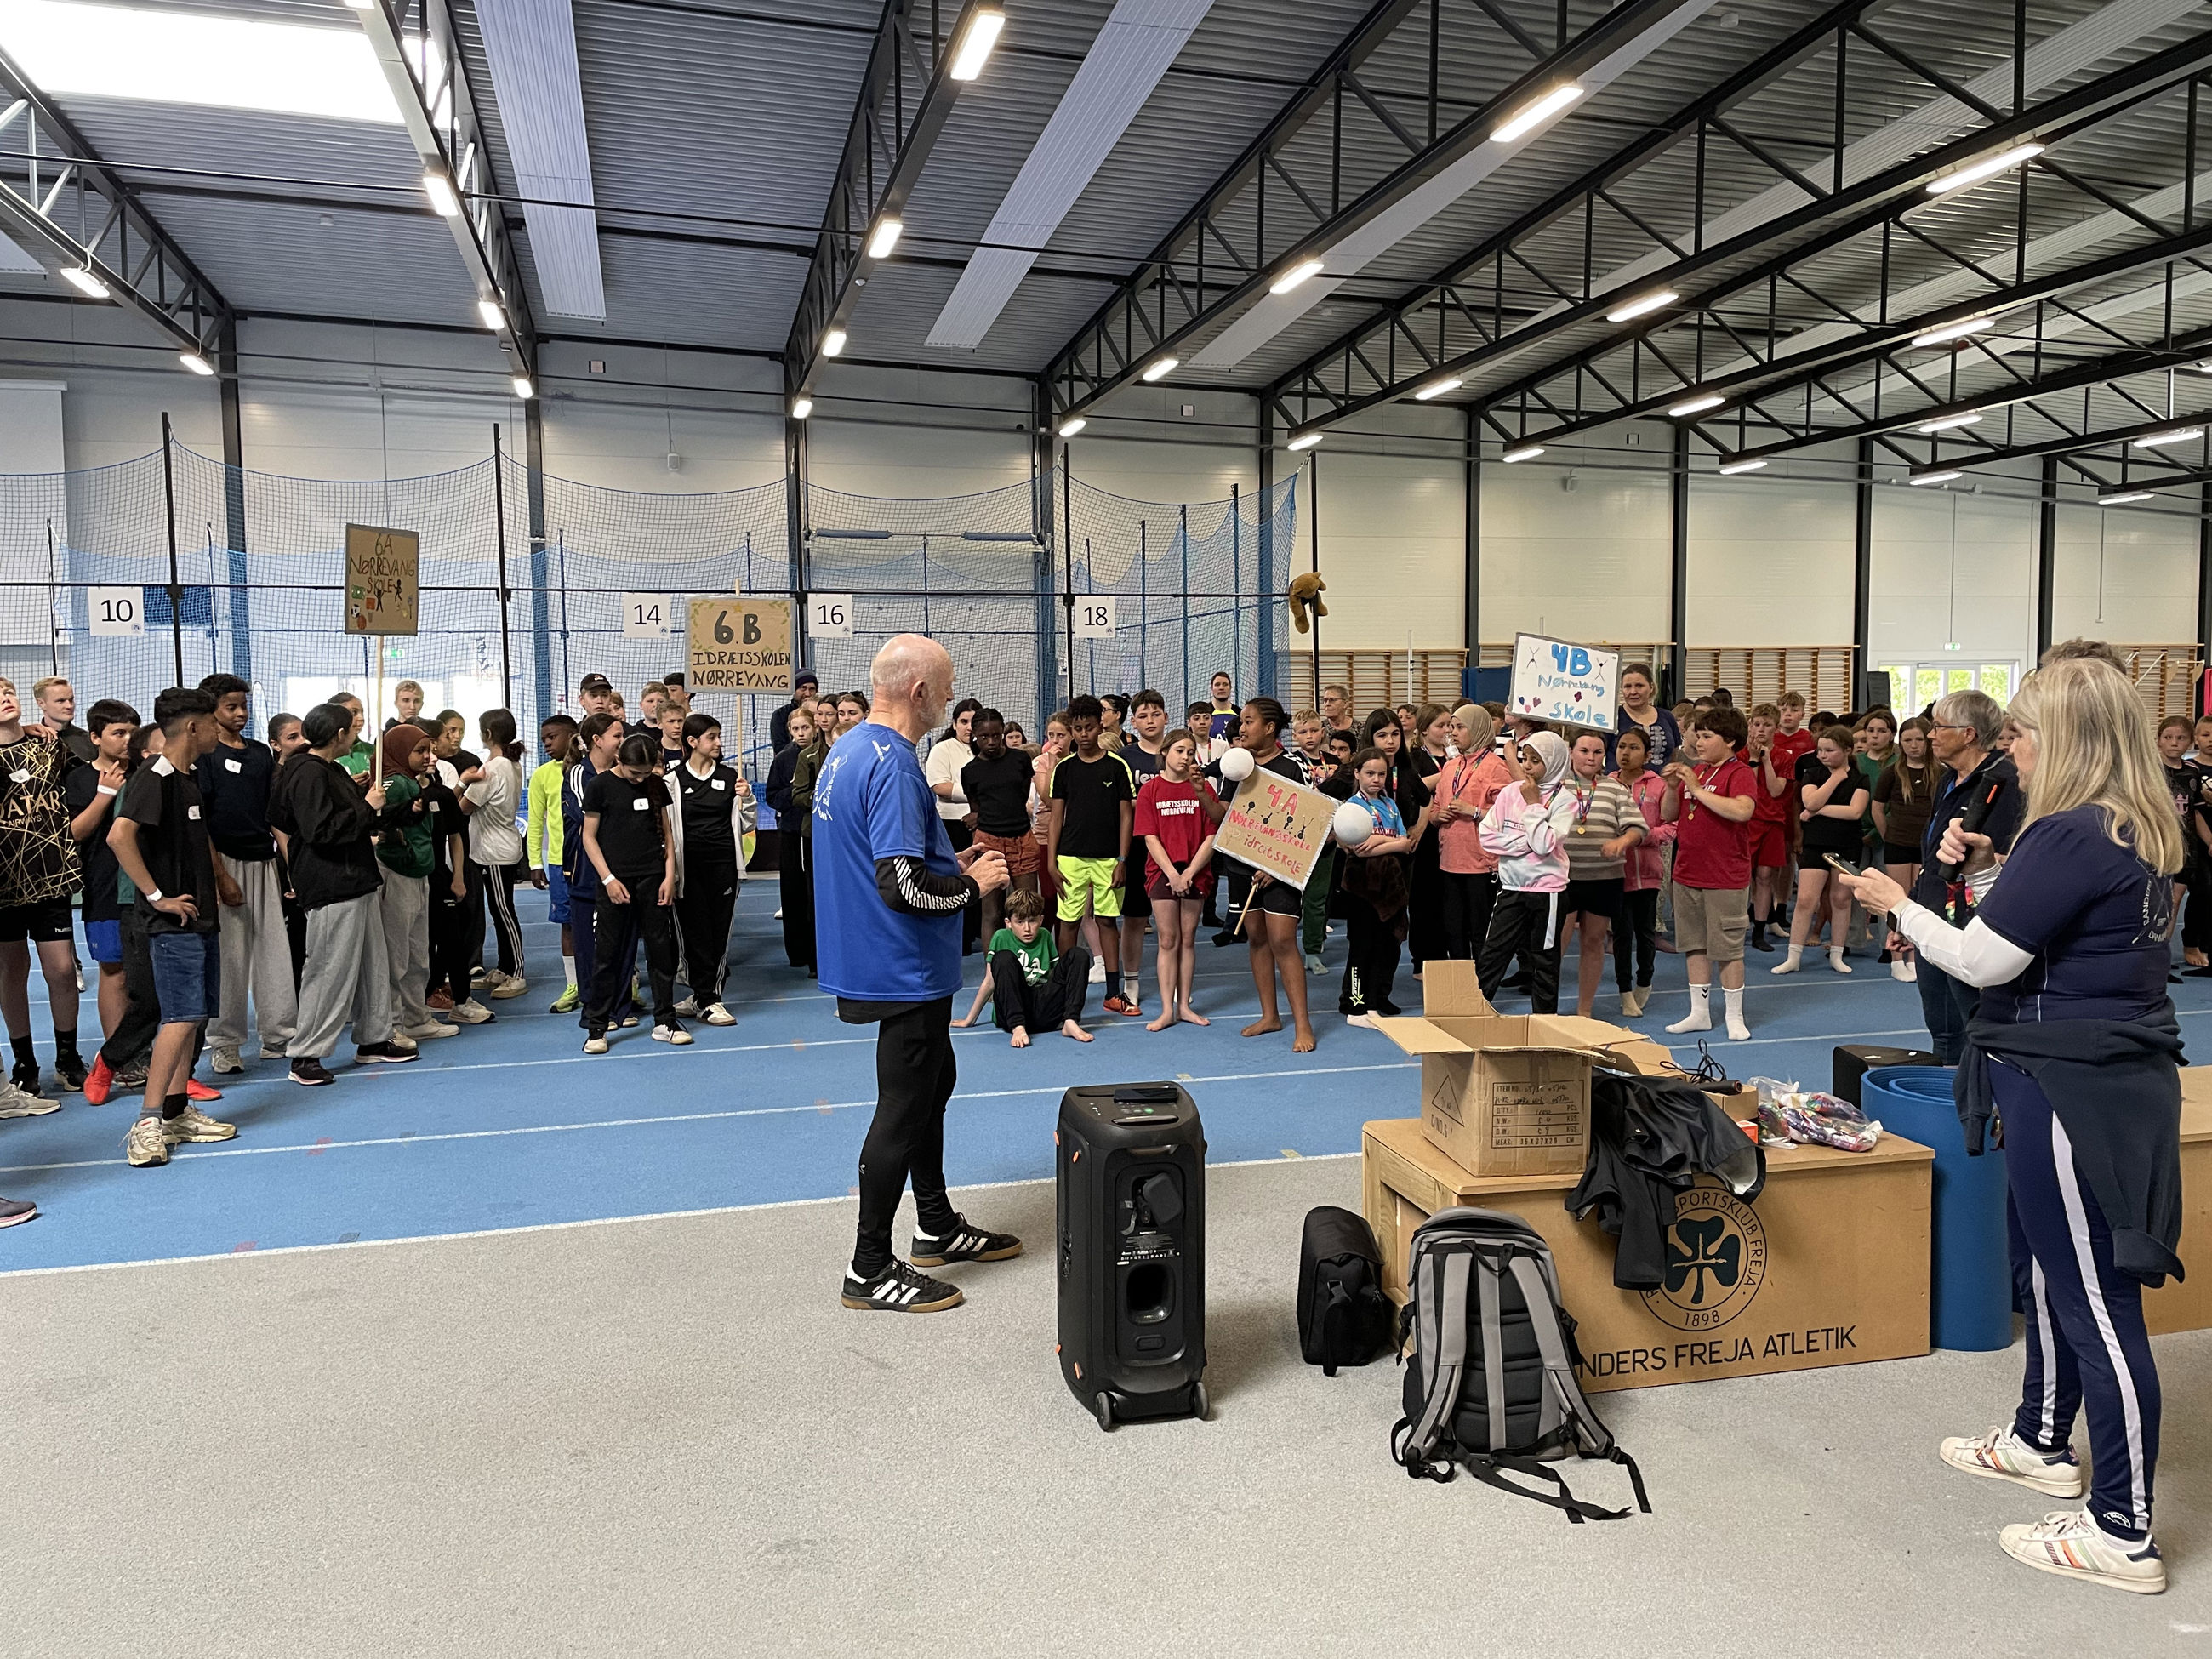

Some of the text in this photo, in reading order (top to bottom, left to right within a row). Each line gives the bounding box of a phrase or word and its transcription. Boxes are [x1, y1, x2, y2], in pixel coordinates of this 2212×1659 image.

[374, 533, 393, 556] 6A
[349, 554, 416, 577] NØRREVANG
[100, 599, 134, 622] 10
[634, 604, 662, 625] 14
[818, 605, 844, 625] 16
[1084, 606, 1108, 626] 18
[693, 651, 790, 667] IDRÆTSSKOLEN
[1551, 643, 1592, 677] 4B
[693, 670, 789, 688] NØRREVANG
[1743, 1239, 1764, 1287] FREJA
[1685, 1310, 1720, 1327] 1898
[1580, 1325, 1856, 1379] NDERS FREJA ATLETIK
